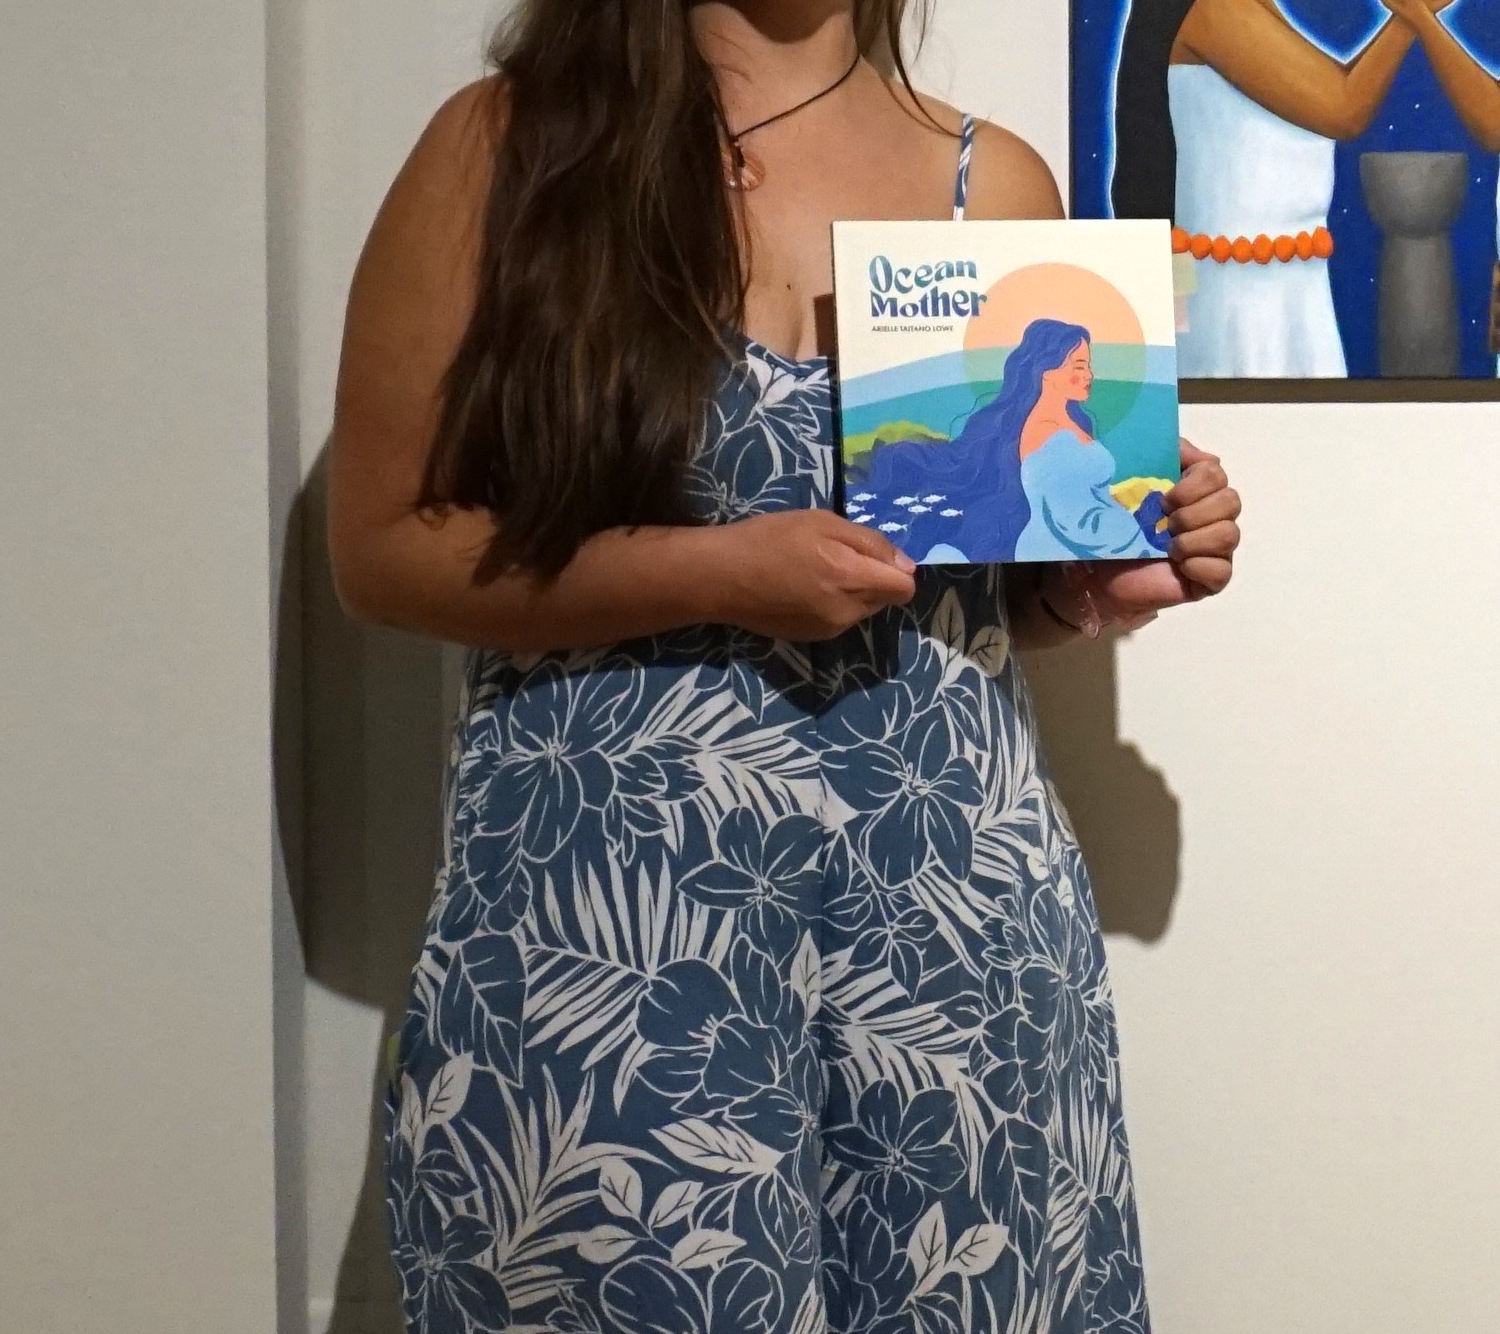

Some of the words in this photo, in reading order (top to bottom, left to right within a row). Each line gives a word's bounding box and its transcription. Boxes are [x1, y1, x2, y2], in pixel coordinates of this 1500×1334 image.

[869, 255, 977, 294] Ocean
[870, 286, 987, 317] Mother
[871, 325, 899, 333] ARIELLE
[900, 325, 931, 333] TAITANO
[932, 325, 954, 333] LOWE
